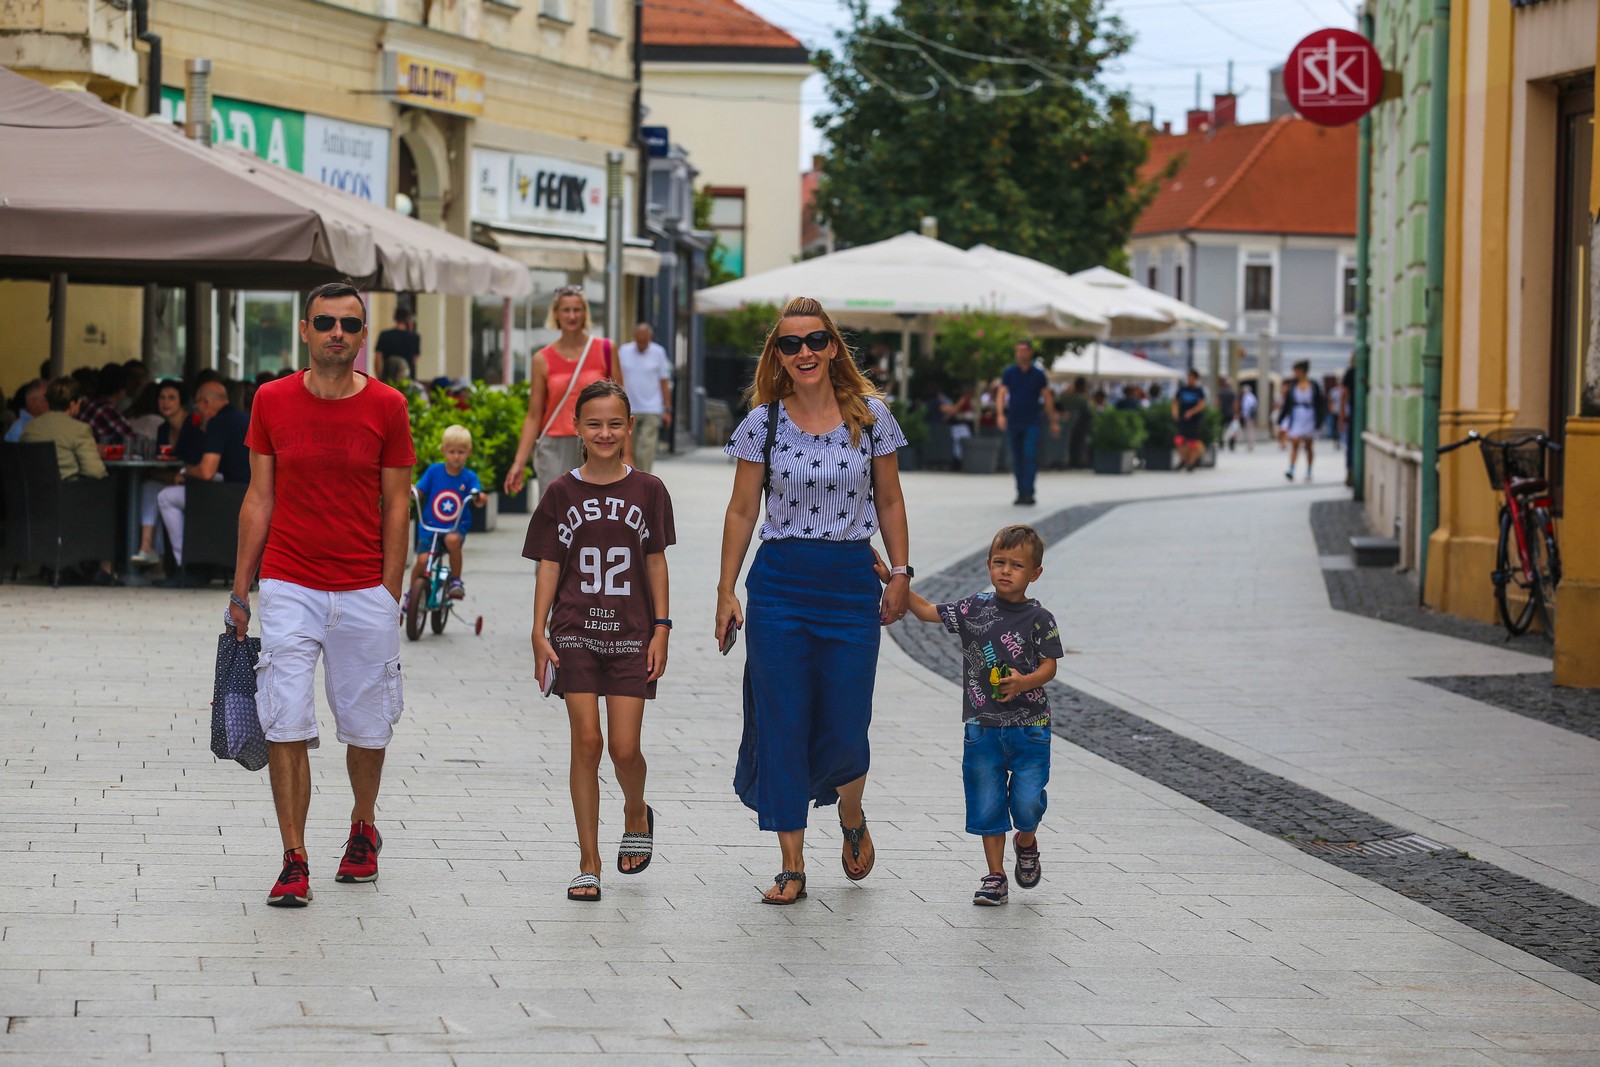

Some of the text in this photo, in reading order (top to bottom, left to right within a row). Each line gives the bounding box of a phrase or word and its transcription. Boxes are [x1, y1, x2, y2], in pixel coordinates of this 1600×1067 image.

[557, 496, 650, 549] BOSTON
[580, 547, 631, 595] 92
[589, 607, 616, 618] GIRLS
[555, 635, 577, 643] COMING
